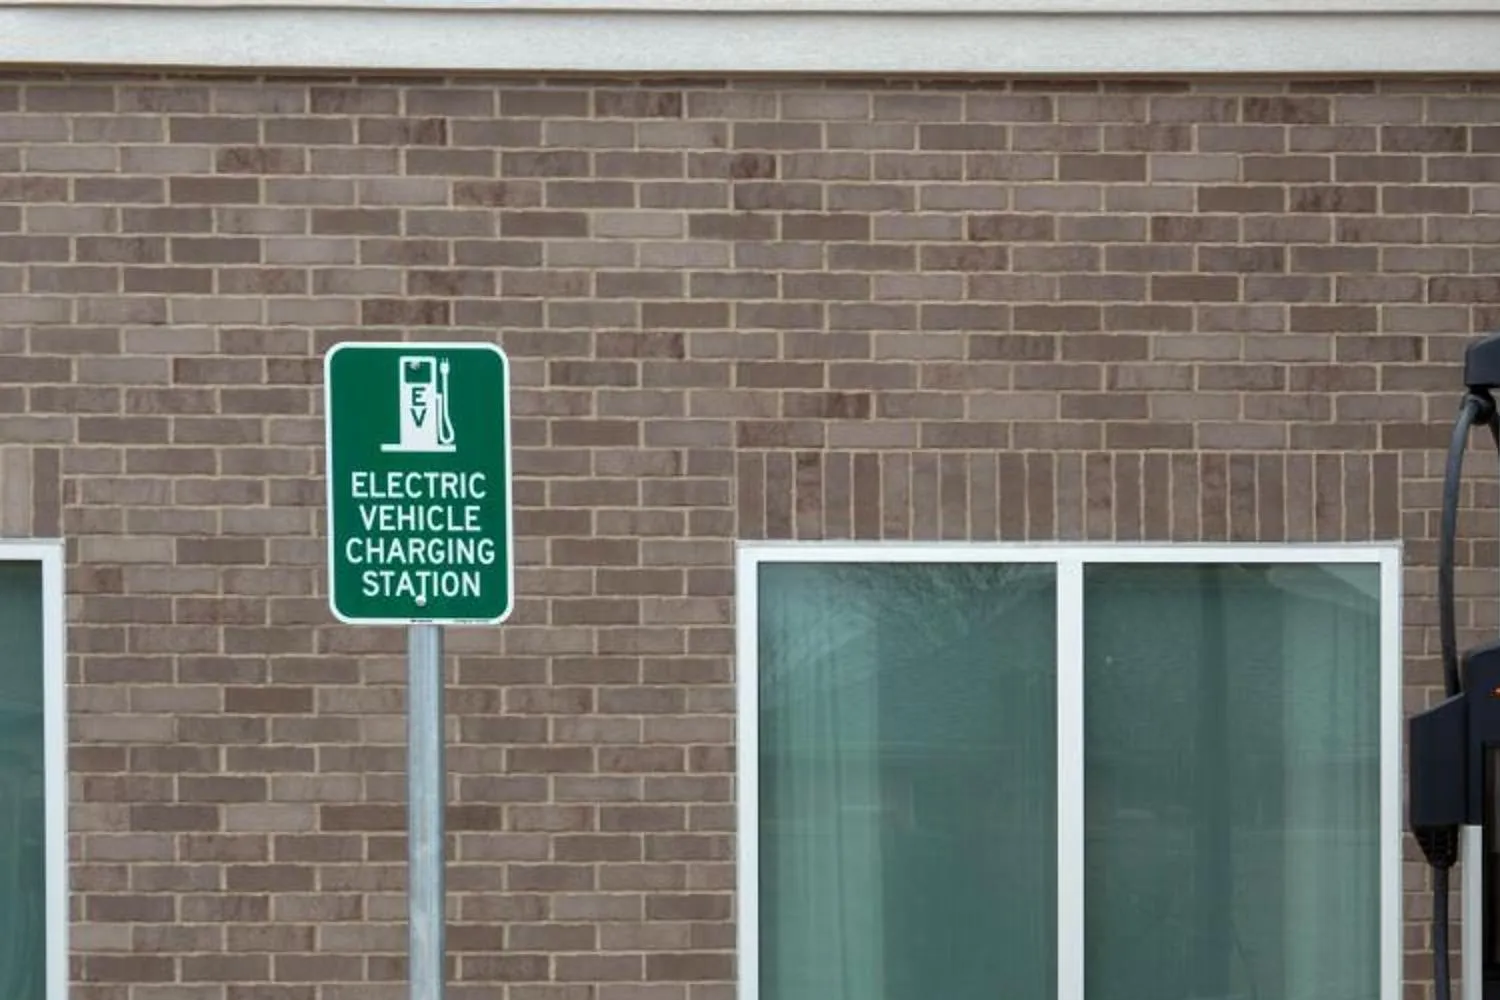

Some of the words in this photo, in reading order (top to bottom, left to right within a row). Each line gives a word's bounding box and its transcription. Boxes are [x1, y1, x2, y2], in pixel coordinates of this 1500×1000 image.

[351, 471, 487, 499] ELECTRIC
[359, 505, 481, 532] VEHICLE
[345, 537, 496, 565] CHARGING
[361, 570, 482, 598] STATION
